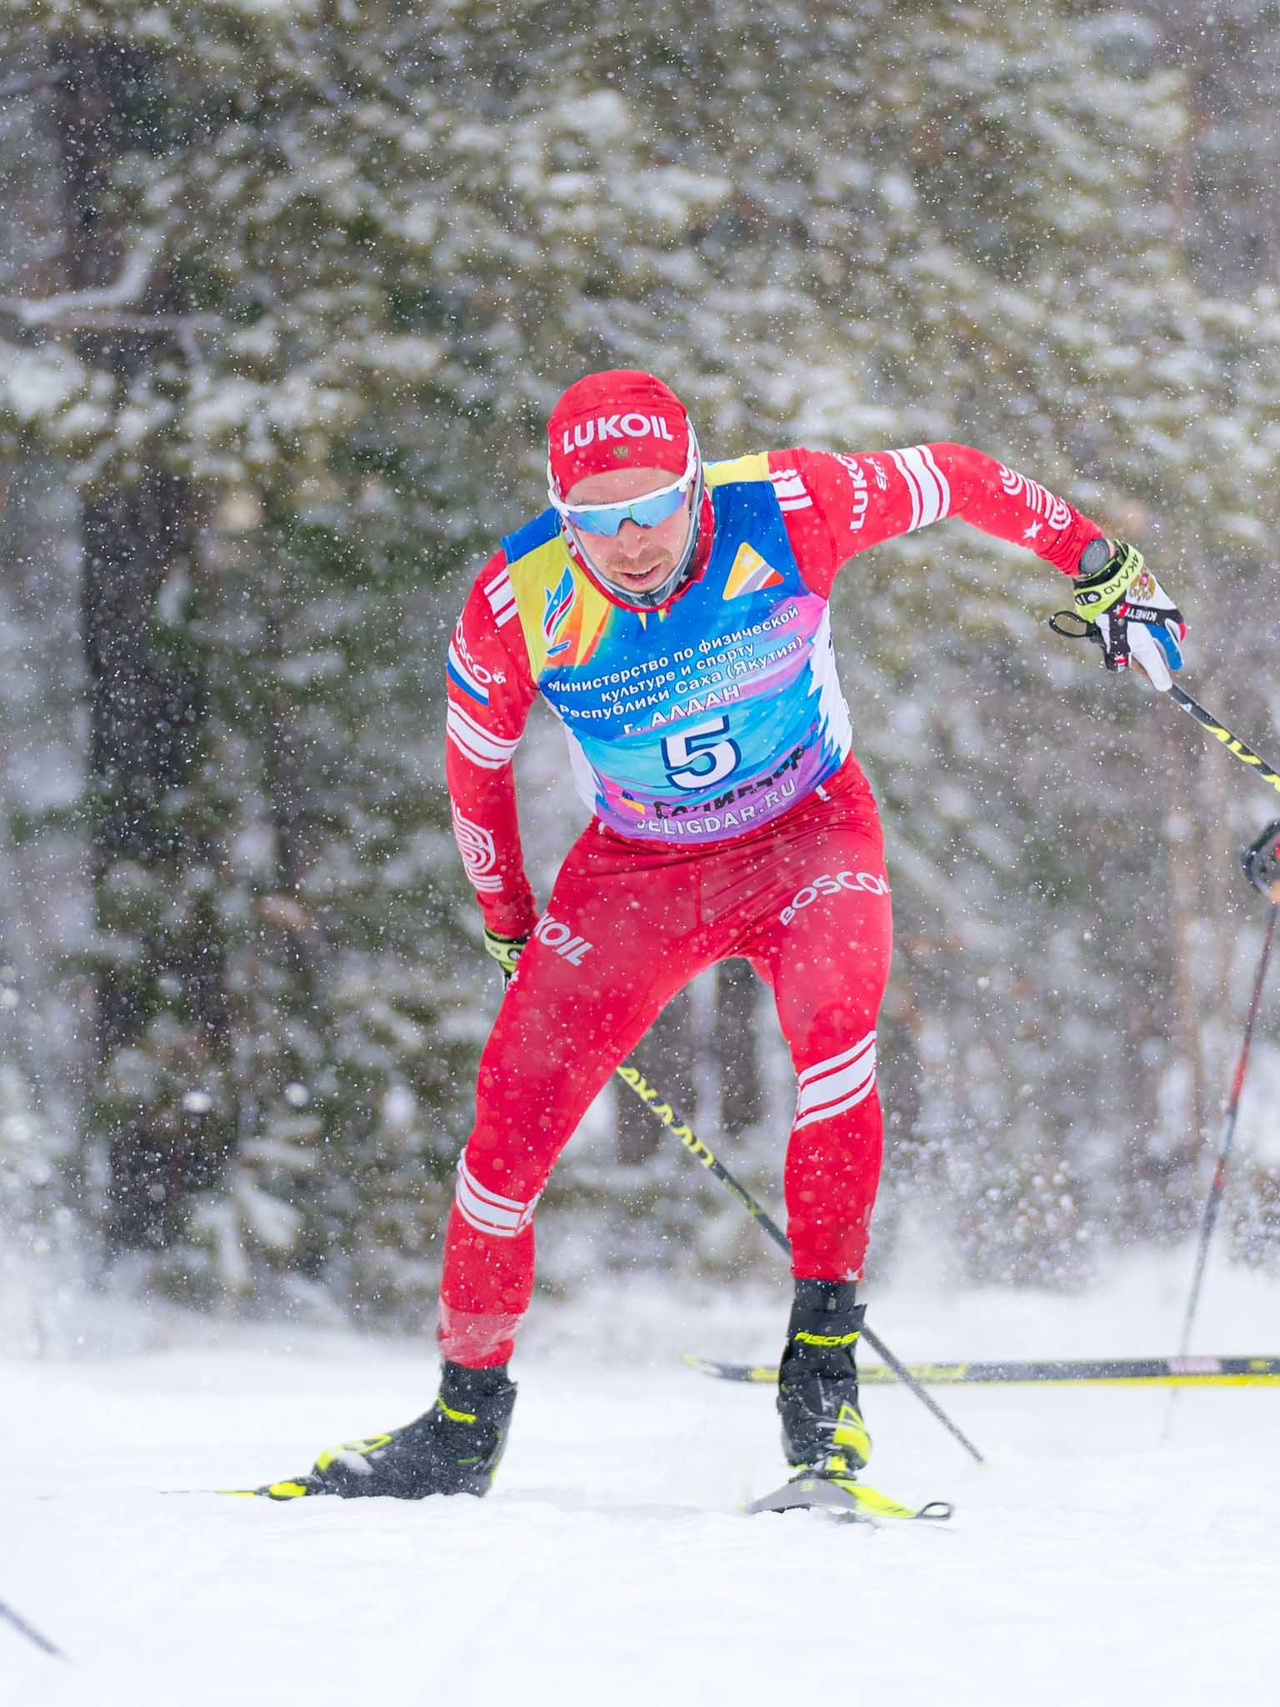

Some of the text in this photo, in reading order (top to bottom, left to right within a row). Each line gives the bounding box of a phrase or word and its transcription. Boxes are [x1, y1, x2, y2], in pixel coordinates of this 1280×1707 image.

[562, 413, 674, 455] LUKOIL
[833, 452, 869, 531] LUKO
[455, 617, 492, 684] OSCO
[547, 656, 669, 692] Министерство
[673, 647, 694, 663] по
[698, 605, 799, 654] физической
[559, 636, 804, 720] Республики Саха (Якутия)
[601, 643, 755, 703] культуре и спорту
[651, 684, 741, 728] АЛДАН
[660, 714, 742, 791] 5
[779, 871, 884, 927] BOSCO
[533, 911, 594, 967] KOIL
